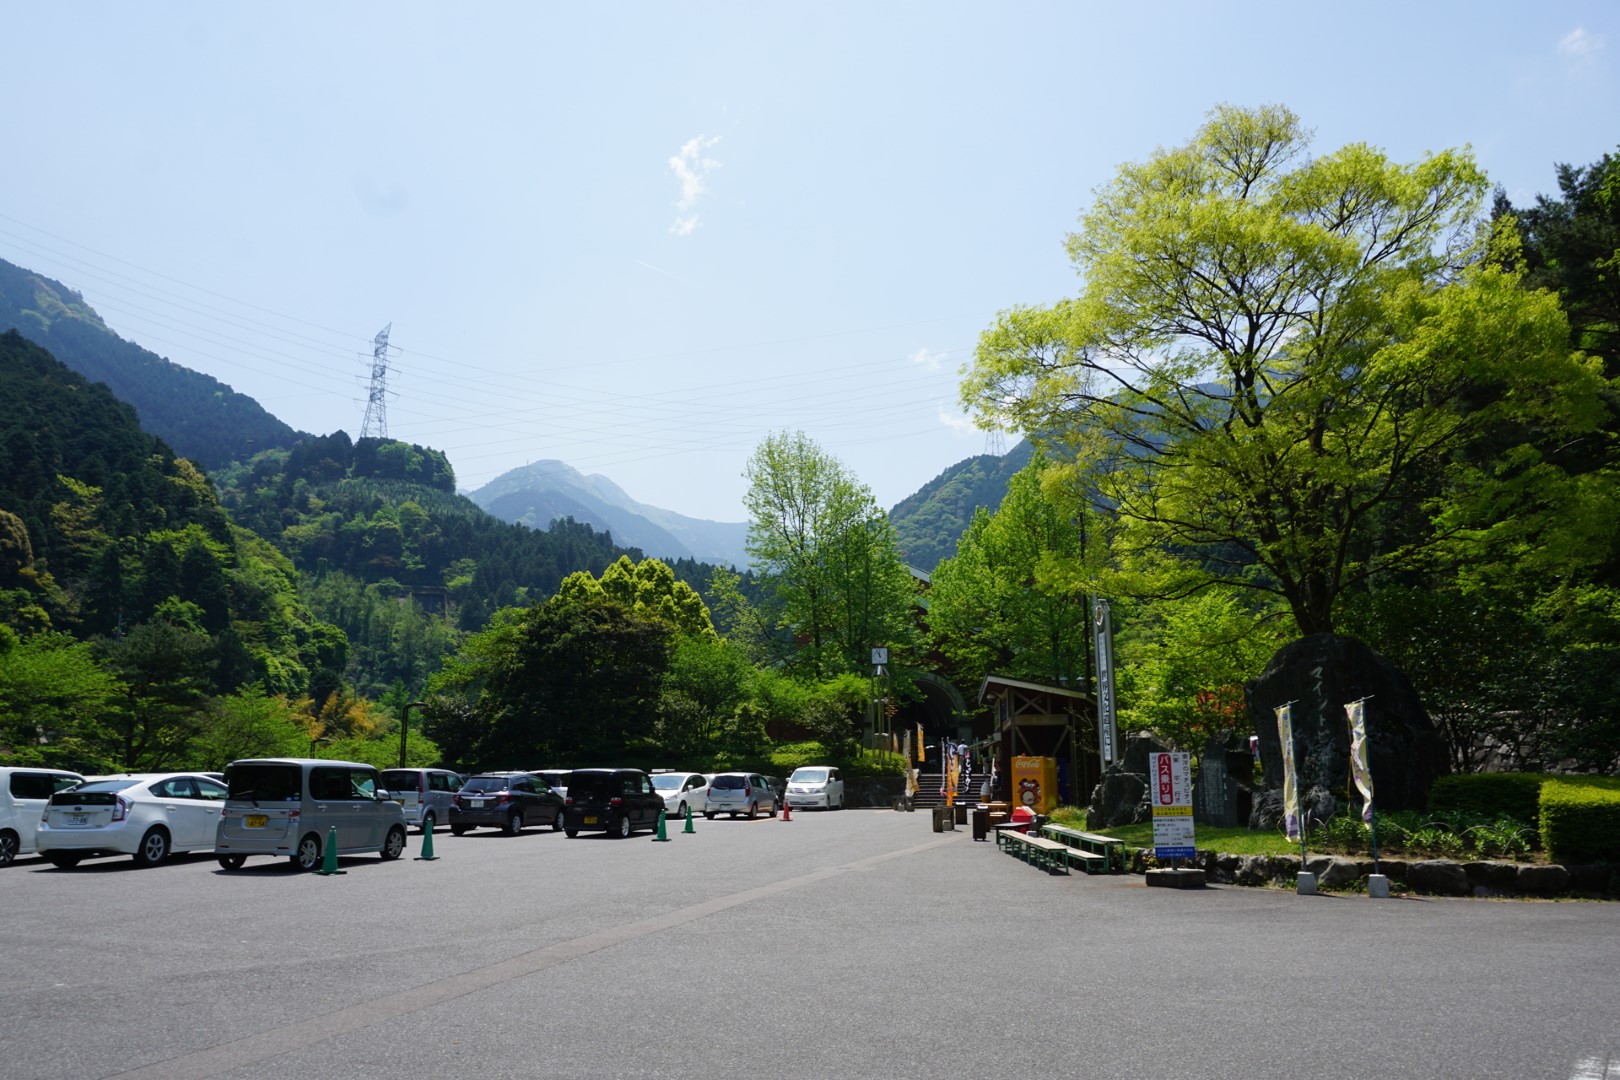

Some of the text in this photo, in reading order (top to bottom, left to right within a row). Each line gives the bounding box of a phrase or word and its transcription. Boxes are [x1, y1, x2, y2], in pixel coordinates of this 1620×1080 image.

[1160, 755, 1171, 803] バス乗り場
